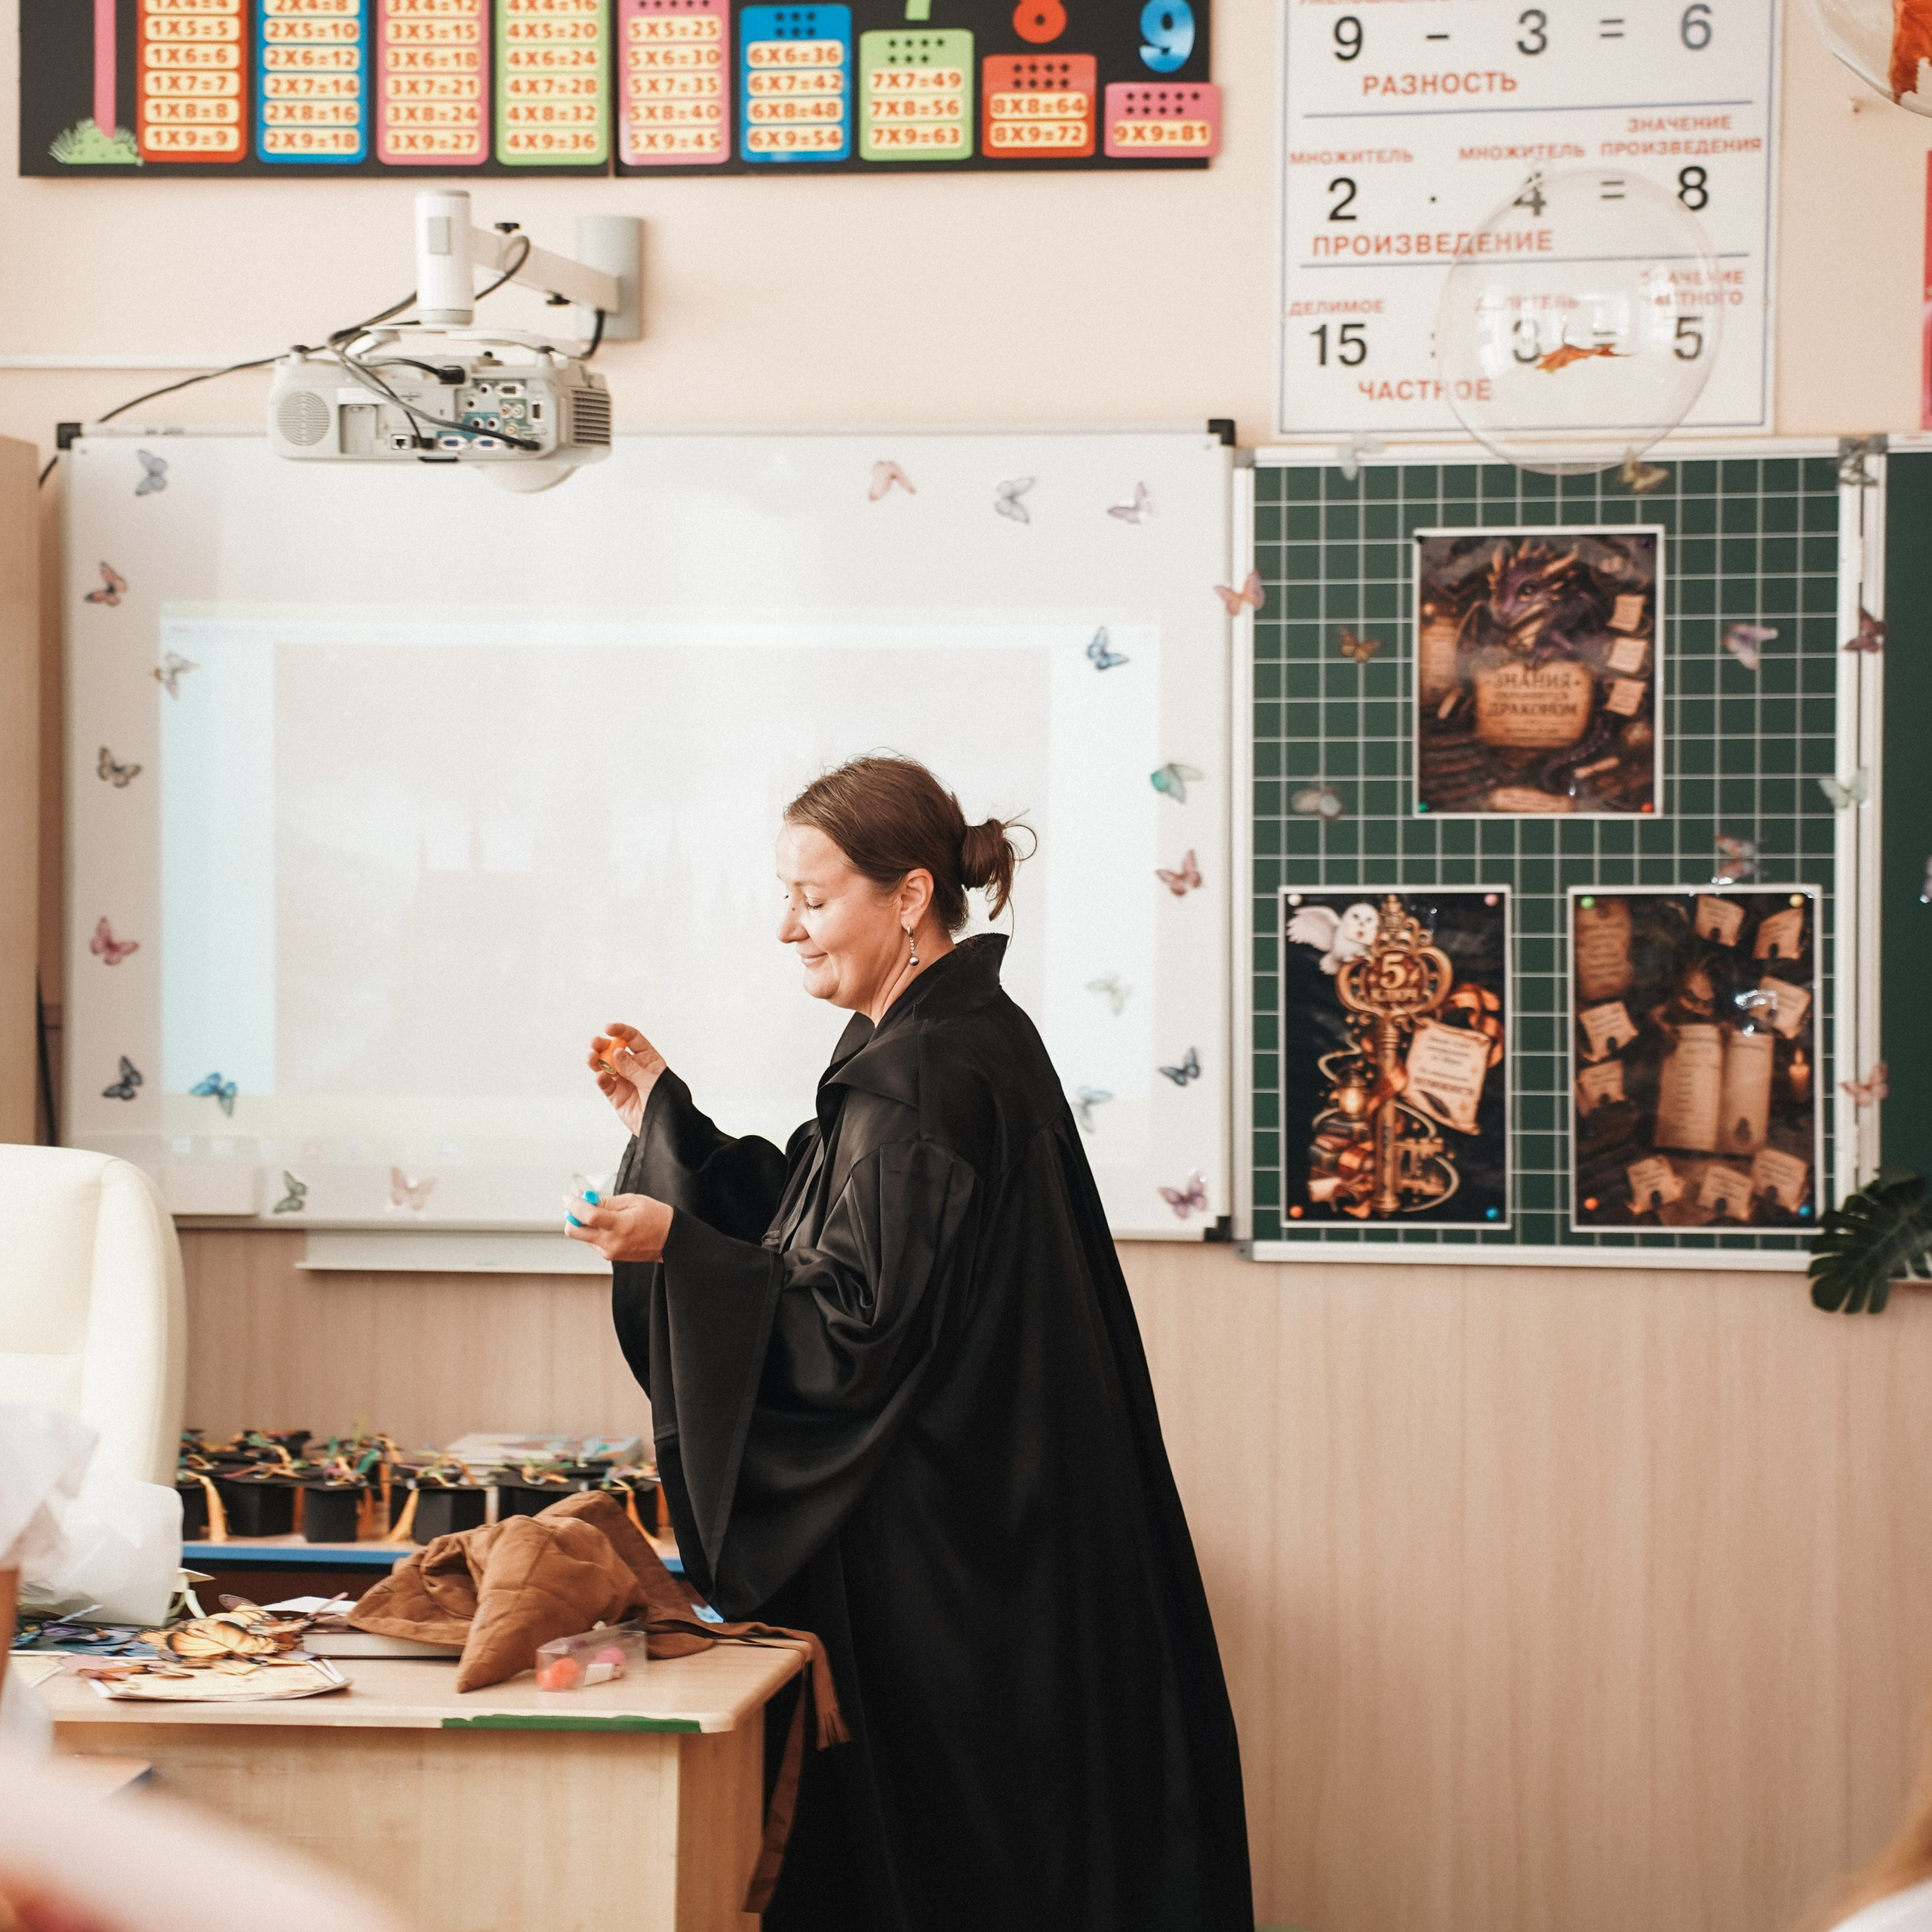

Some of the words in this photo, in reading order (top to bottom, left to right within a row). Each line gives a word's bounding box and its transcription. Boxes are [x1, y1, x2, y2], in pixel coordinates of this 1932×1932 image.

[1140, 0, 1195, 73] 9
[1334, 15, 1363, 61] 9
[1517, 9, 1548, 55] 3
[1680, 4, 1712, 50] 6
[1362, 71, 1517, 95] РАЗНОСТЬ
[1628, 115, 1731, 133] ЗНАЧЕНИЕ
[1290, 148, 1414, 165] МНОЖИТЕЛЬ
[1459, 142, 1585, 161] МНОЖИТЕЛЬ
[1601, 136, 1762, 158] ПРОИЗВЕДЕНИЯ
[1328, 177, 1358, 220] 2
[1513, 172, 1546, 217] 4
[1678, 166, 1708, 211] 8
[1312, 229, 1552, 257] ПРОИЗВЕДЕНИЕ
[1290, 300, 1385, 316] ДЕЛИМОЕ
[1311, 324, 1367, 366] 15
[1674, 316, 1703, 360] 5
[1380, 954, 1407, 989] 5
